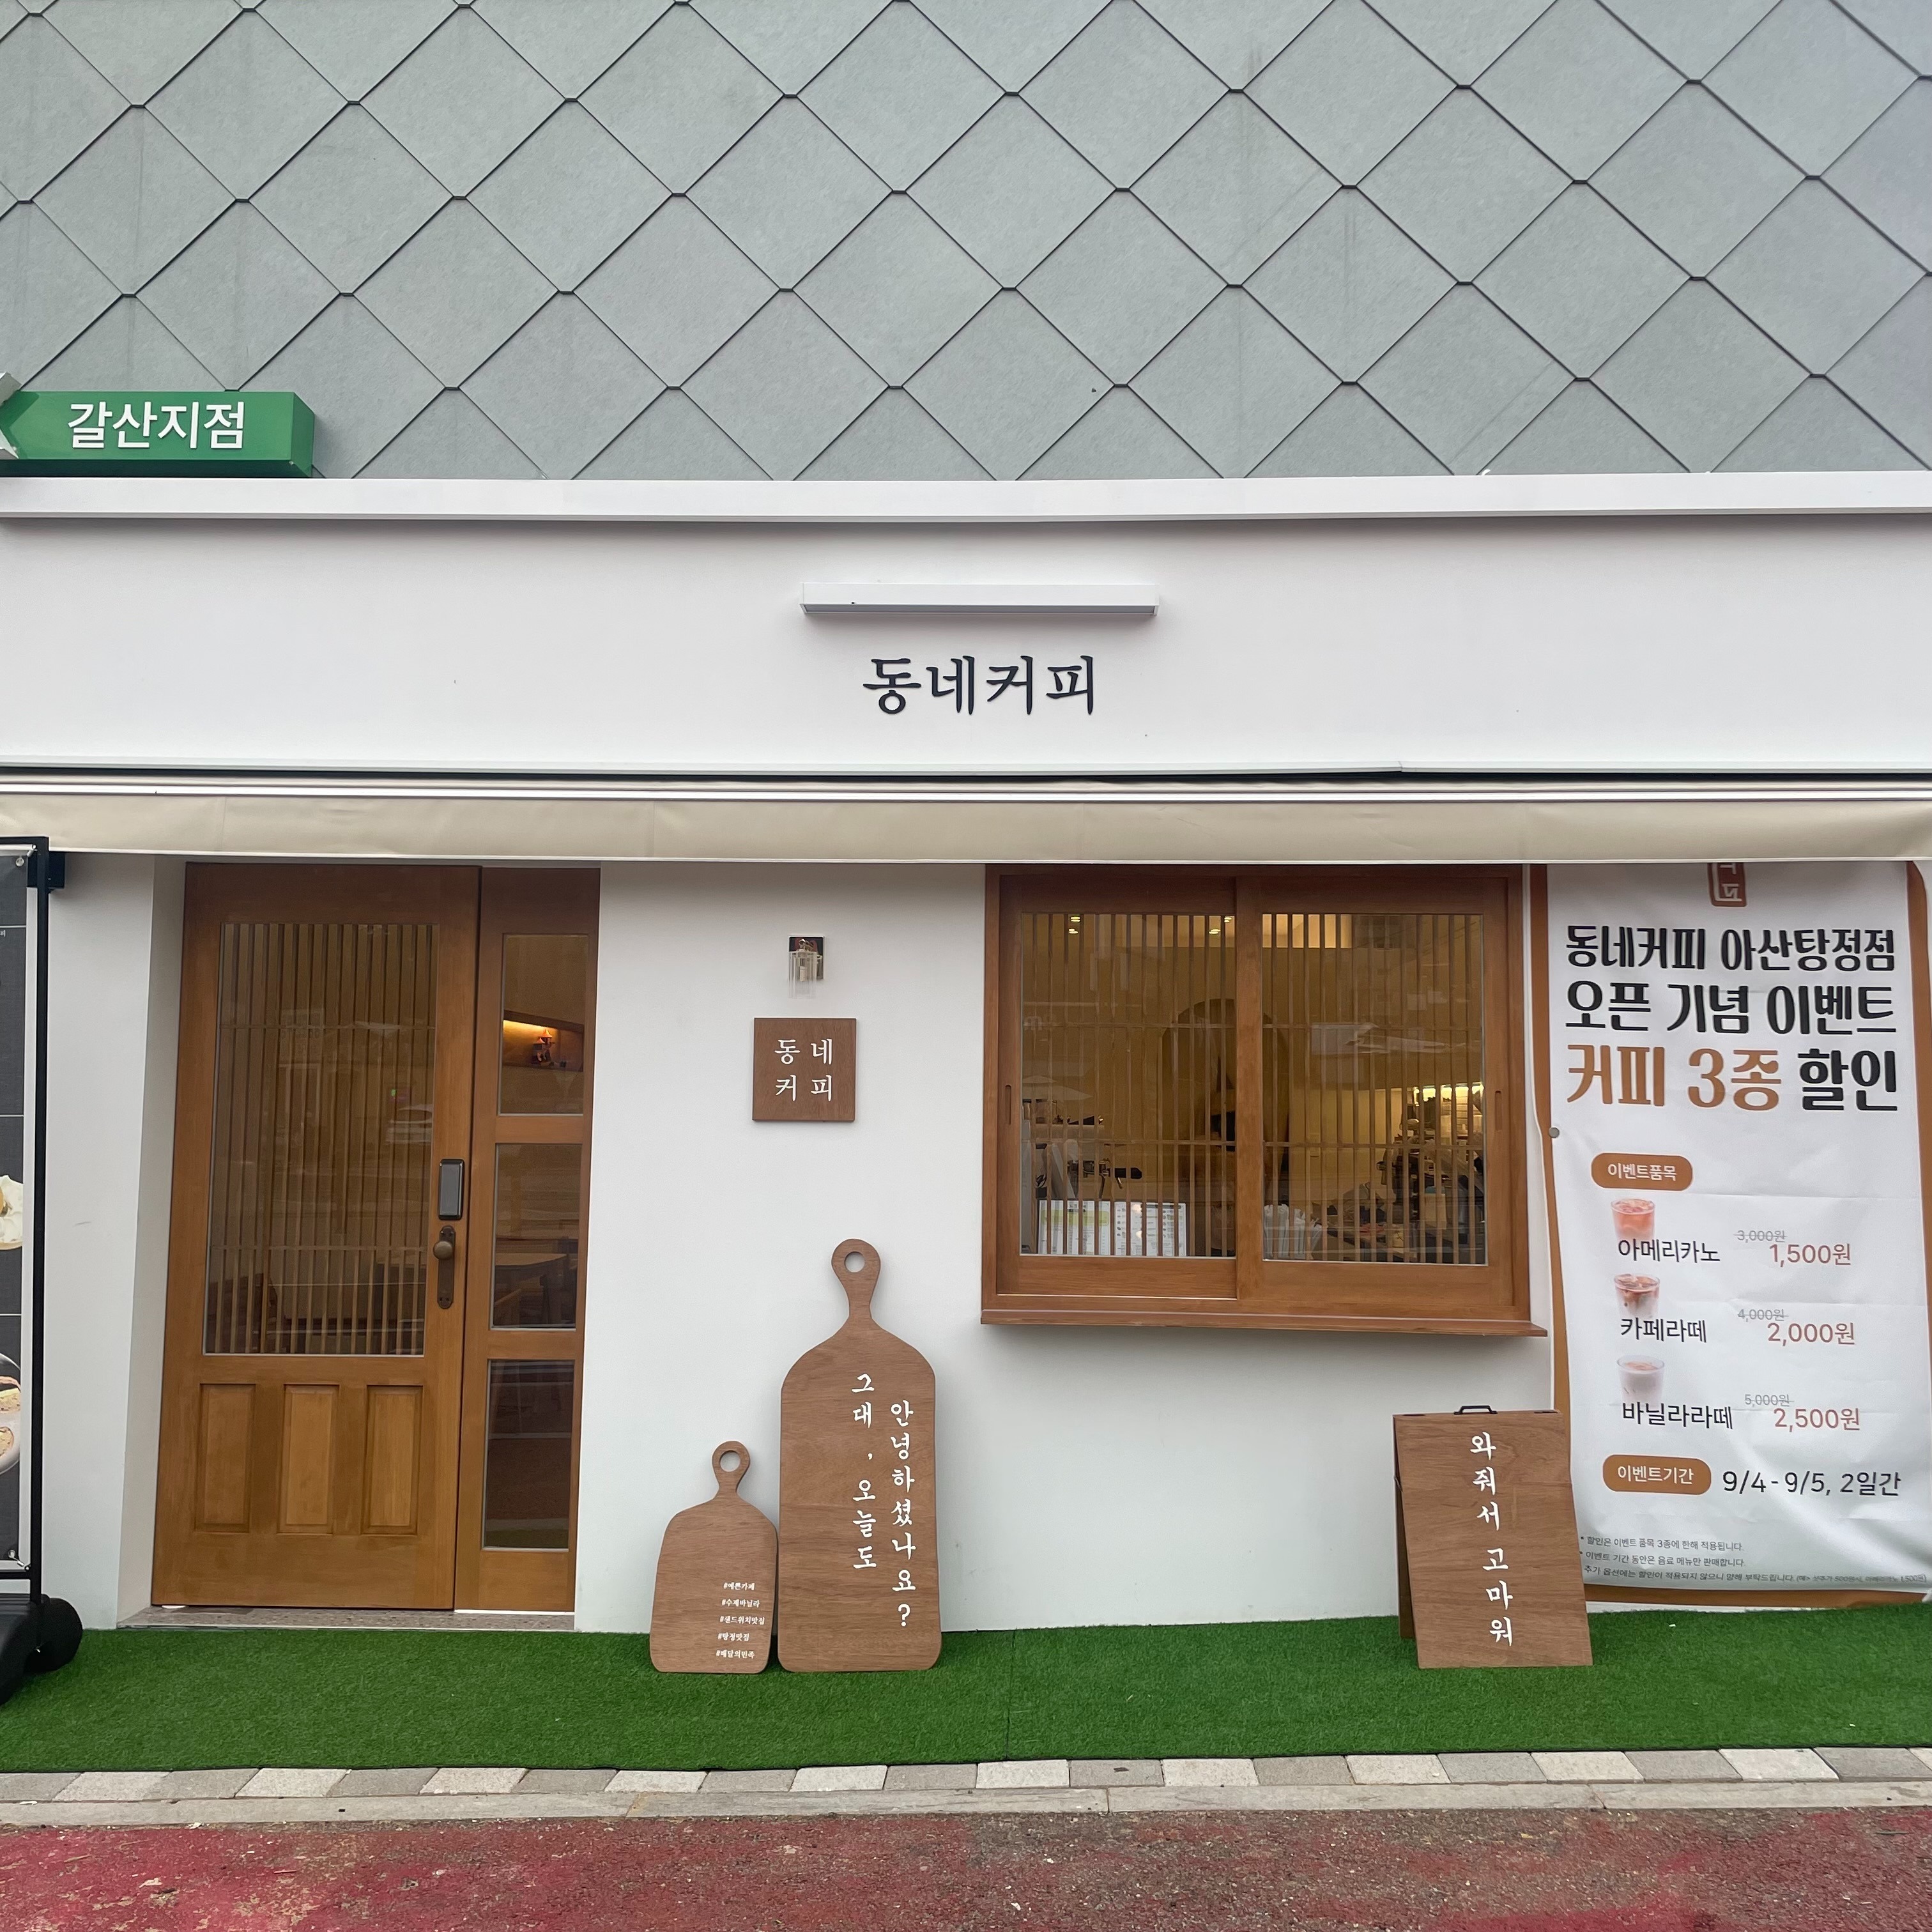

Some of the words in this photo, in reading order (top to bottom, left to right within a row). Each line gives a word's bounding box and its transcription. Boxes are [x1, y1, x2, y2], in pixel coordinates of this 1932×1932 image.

[68, 401, 245, 449] 갈산지점
[863, 655, 1094, 715] 동네커피
[1566, 925, 1706, 970] 동네커피
[1721, 929, 1895, 971] 아산탕정점
[1565, 980, 1651, 1031] 오픈
[1667, 984, 1749, 1034] 기념
[1767, 986, 1897, 1035] 이벤트
[774, 1038, 833, 1065] 동네
[775, 1074, 832, 1101] 커피
[1567, 1045, 1666, 1107] 커피
[1688, 1048, 1782, 1111] 3종
[1798, 1048, 1898, 1111] 할인
[1607, 1163, 1678, 1181] 이벤트품목
[1736, 1230, 1786, 1244] 3,000원
[1618, 1239, 1721, 1264] 아메리카노
[1769, 1243, 1852, 1268] 1,500원
[1737, 1308, 1785, 1322] 4,000원
[1620, 1318, 1707, 1343] 카페라떼
[1767, 1322, 1855, 1346] 2,000원
[1744, 1393, 1790, 1407] 5,000원
[1621, 1402, 1733, 1430] 바닐라라떼
[1773, 1407, 1860, 1432] 2,500원
[1469, 1432, 1500, 1531] 와줘서
[1618, 1465, 1694, 1485] 이벤트기간
[1840, 1471, 1901, 1496] 2일간
[853, 1480, 877, 1569] 오늘도
[891, 1399, 916, 1627] 안녕하셨나요?
[1587, 1537, 1611, 1547] 할인은
[1614, 1538, 1637, 1547] 이벤트
[1639, 1538, 1655, 1548] 품목
[1657, 1539, 1680, 1549] 3종에
[1682, 1540, 1698, 1550] 한해
[1586, 1551, 1610, 1561] 이벤트
[1613, 1554, 1629, 1563] 기간
[1632, 1555, 1655, 1565] 동안은
[1658, 1556, 1674, 1565] 음료
[1676, 1557, 1701, 1566] 메뉴만
[1584, 1565, 1600, 1575] 추가
[1604, 1568, 1636, 1578] 옵션에는
[1638, 1570, 1662, 1579] 할인이
[1665, 1572, 1698, 1580] 적용되지
[721, 1598, 760, 1608] #수제바닐라
[1482, 1547, 1514, 1647] 고마워
[719, 1616, 765, 1625] #샌드위치맛집
[716, 1649, 755, 1659] #배달의민족
